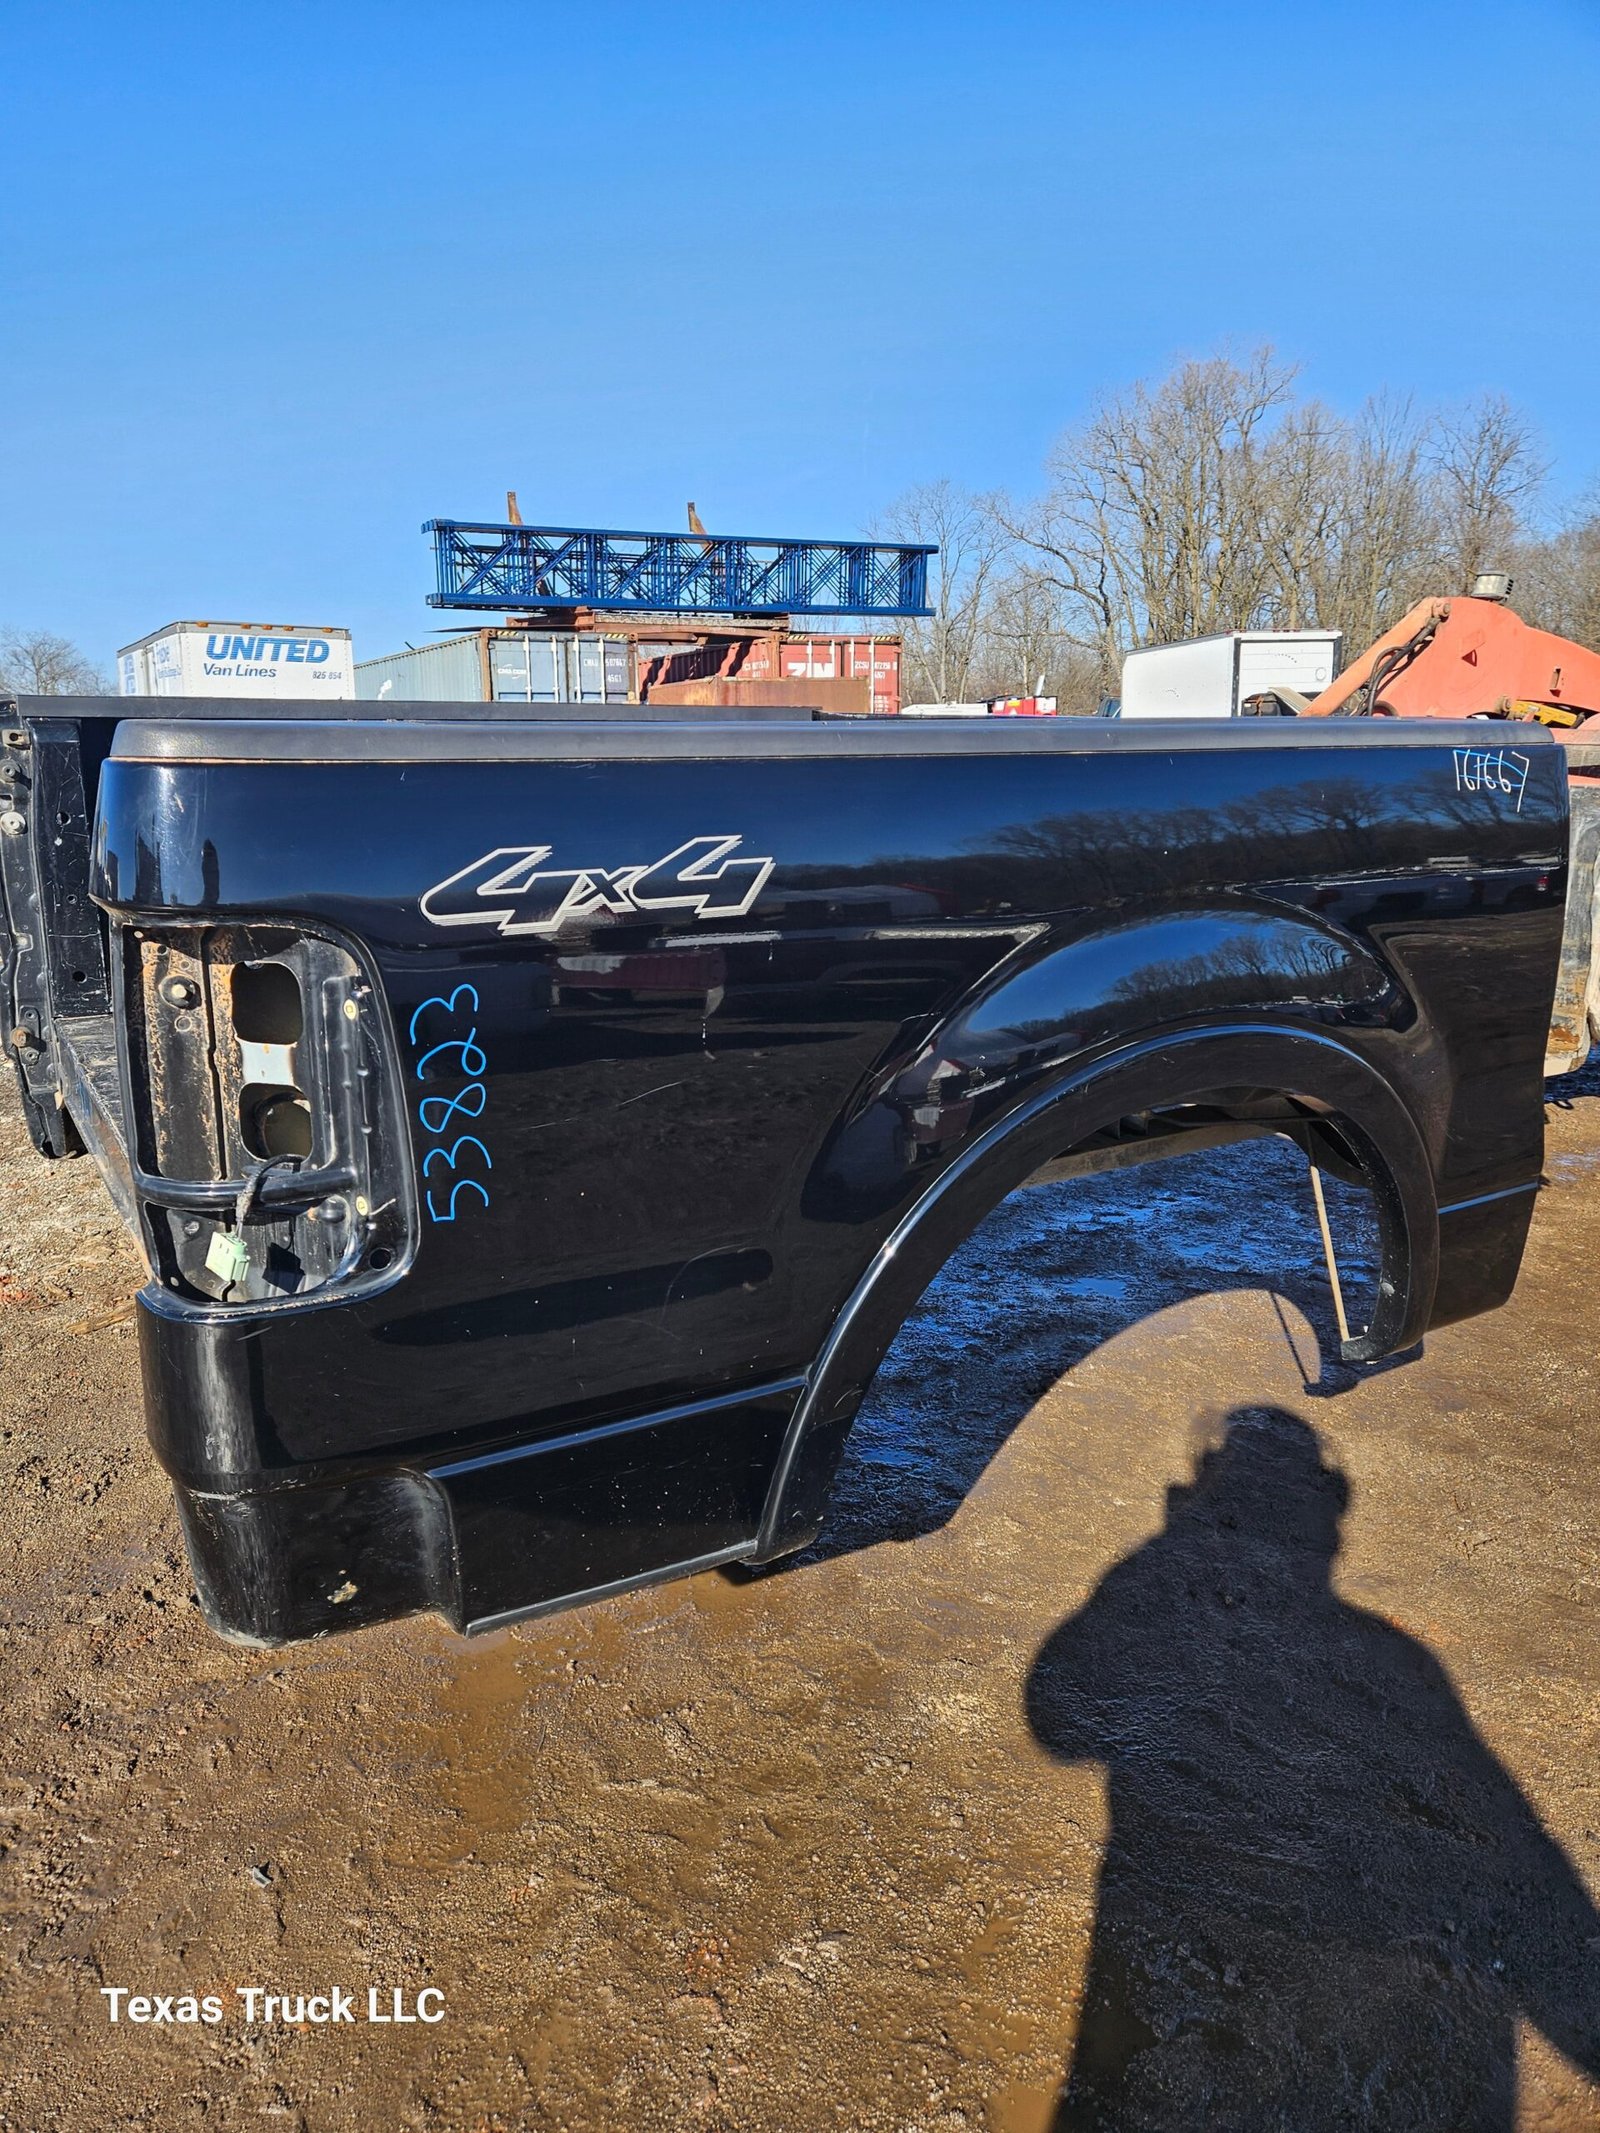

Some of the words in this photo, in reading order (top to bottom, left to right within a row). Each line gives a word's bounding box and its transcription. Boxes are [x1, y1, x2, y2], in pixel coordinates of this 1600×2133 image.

[206, 635, 330, 664] UNITED
[203, 663, 232, 677] Van
[235, 664, 277, 678] Lines
[410, 984, 491, 1222] 53823
